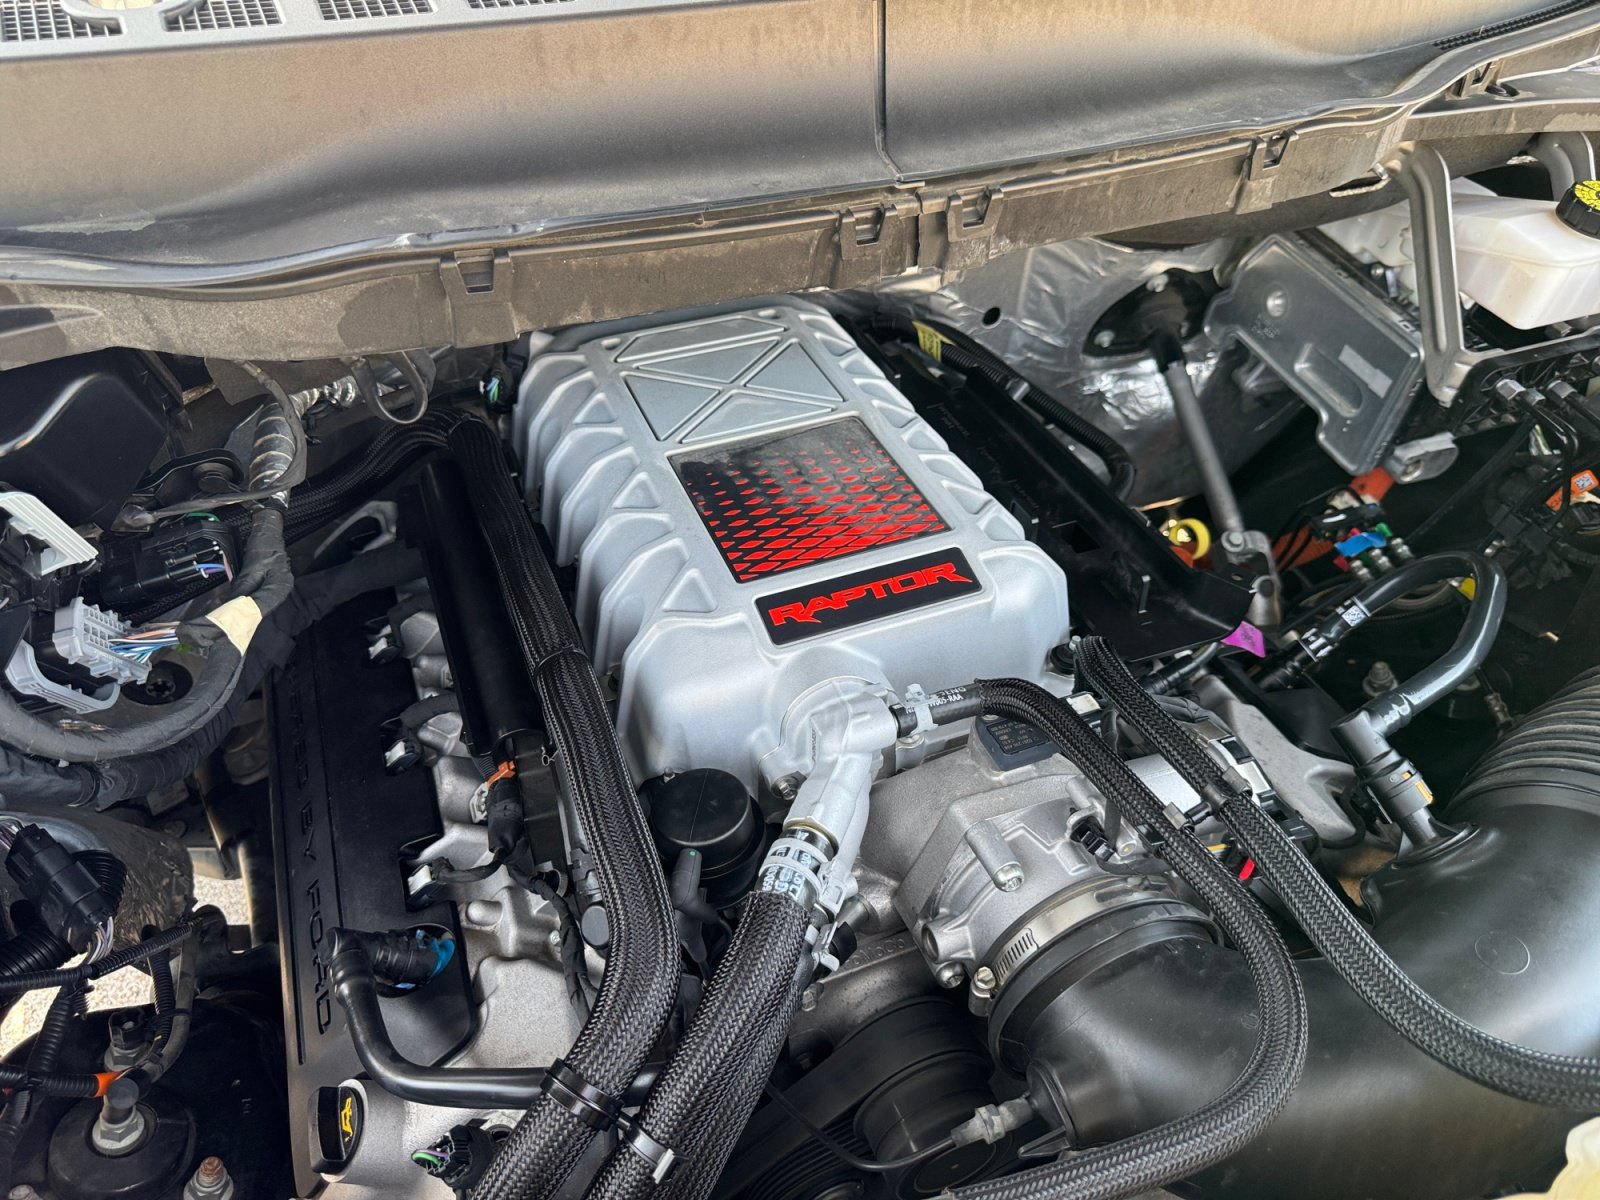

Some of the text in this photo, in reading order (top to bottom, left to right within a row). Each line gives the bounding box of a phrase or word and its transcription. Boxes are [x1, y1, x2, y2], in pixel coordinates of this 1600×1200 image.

[768, 562, 973, 626] RAPTOR
[301, 801, 316, 861] BY
[307, 879, 332, 1035] FORD
